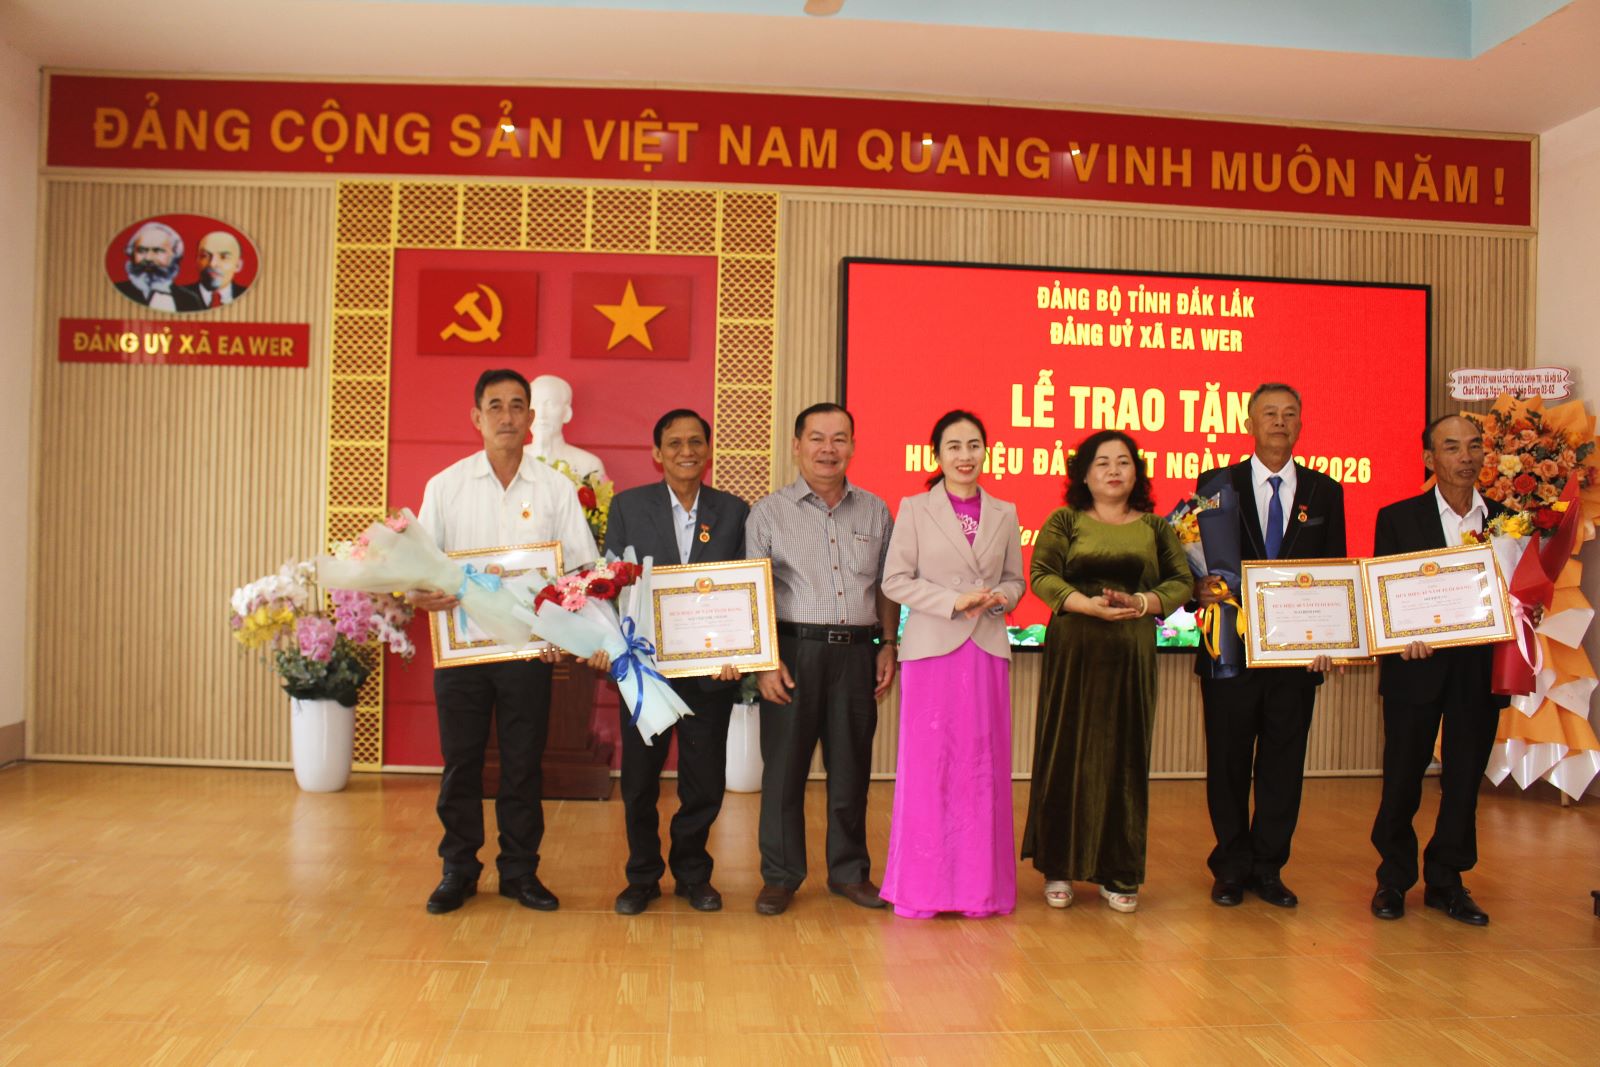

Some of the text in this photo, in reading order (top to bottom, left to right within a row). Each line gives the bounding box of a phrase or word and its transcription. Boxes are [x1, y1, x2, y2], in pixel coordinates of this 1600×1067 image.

[94, 92, 1505, 205] ĐẢNG CỘNG SẢN VIỆT NAM QUANG VINH MUÔN NĂM !
[1036, 280, 1255, 318] ĐẢNG BỘ TỈNH ĐẮK LẮK
[73, 325, 294, 357] ĐẢNG UỶ XÃ EA WER
[1049, 315, 1243, 352] ĐẢNG UỶ XÃ EA WER
[1011, 369, 1251, 443] LỄ TRAO TẶN
[905, 444, 938, 472] HU
[982, 441, 1024, 480] IỆU
